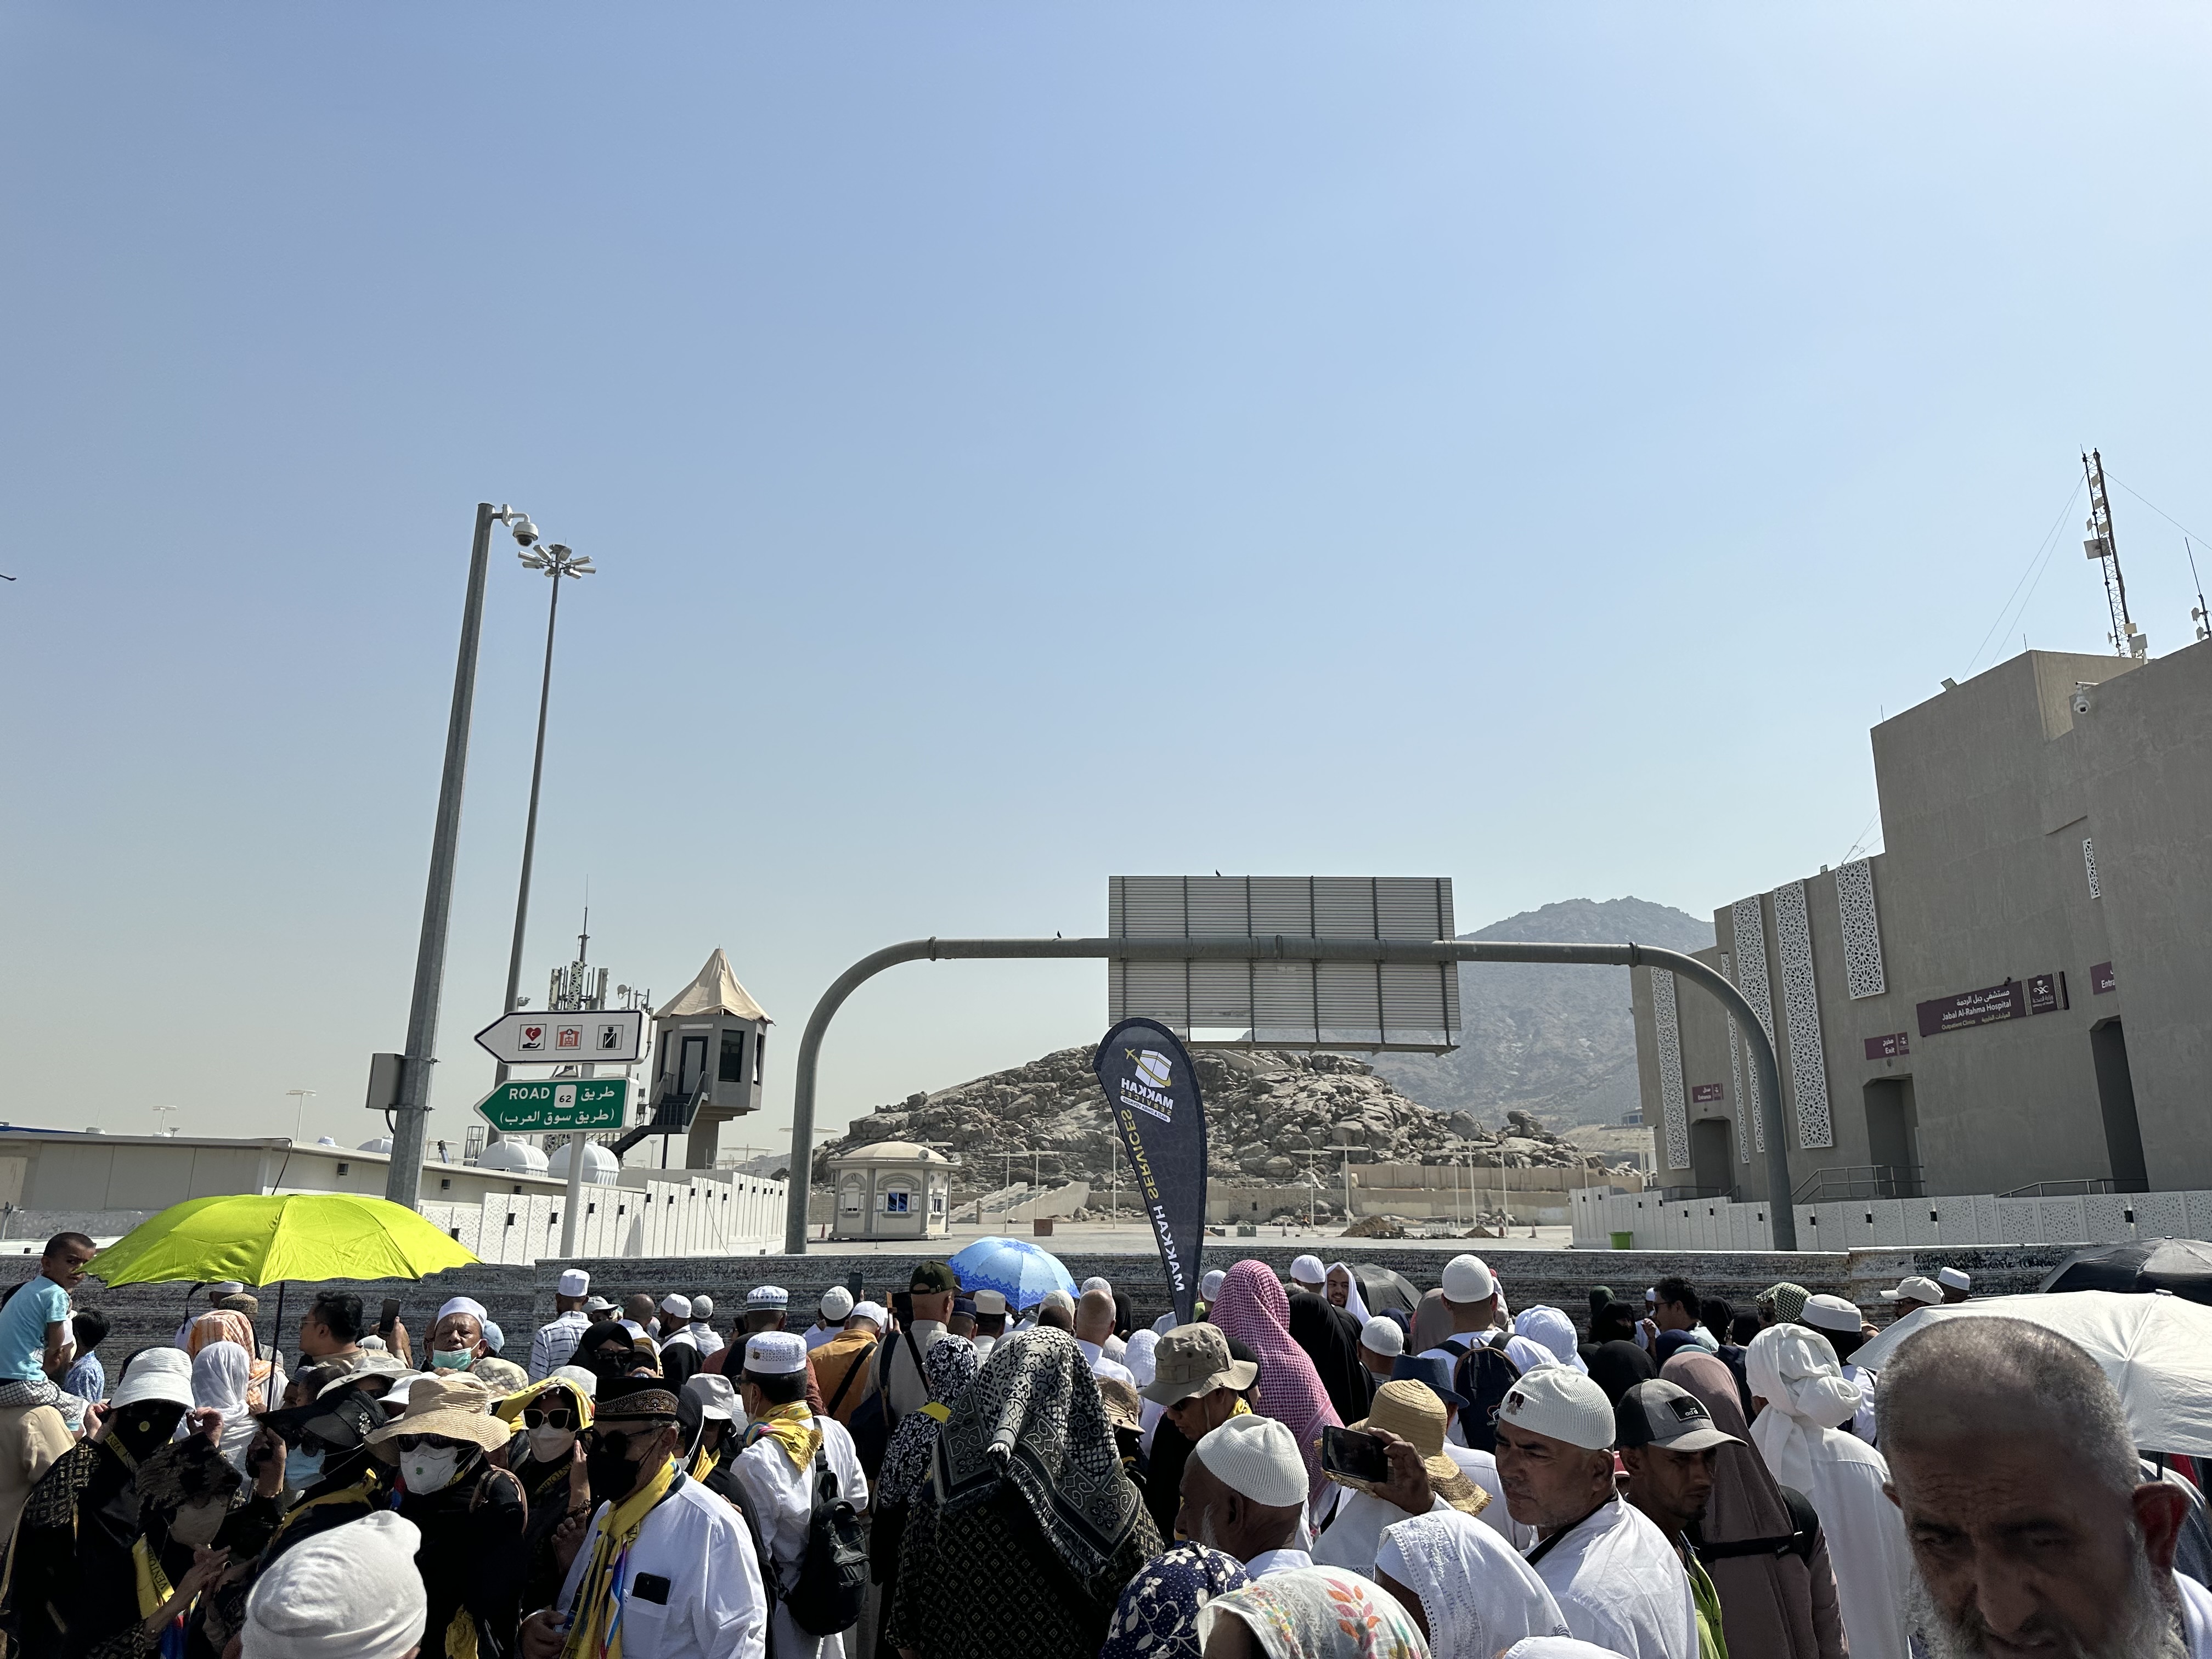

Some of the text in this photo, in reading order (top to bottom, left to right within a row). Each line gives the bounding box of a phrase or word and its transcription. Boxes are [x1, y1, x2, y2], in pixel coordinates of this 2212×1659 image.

[2101, 979, 2115, 989] Entra
[1956, 990, 2010, 1006] مستشفى جبل الرحمة
[1942, 999, 2012, 1021] Jabal Al-Rahma Hospital
[509, 1087, 550, 1100] ROAD
[581, 1086, 615, 1101] طريق
[544, 1112, 571, 1125] سوق
